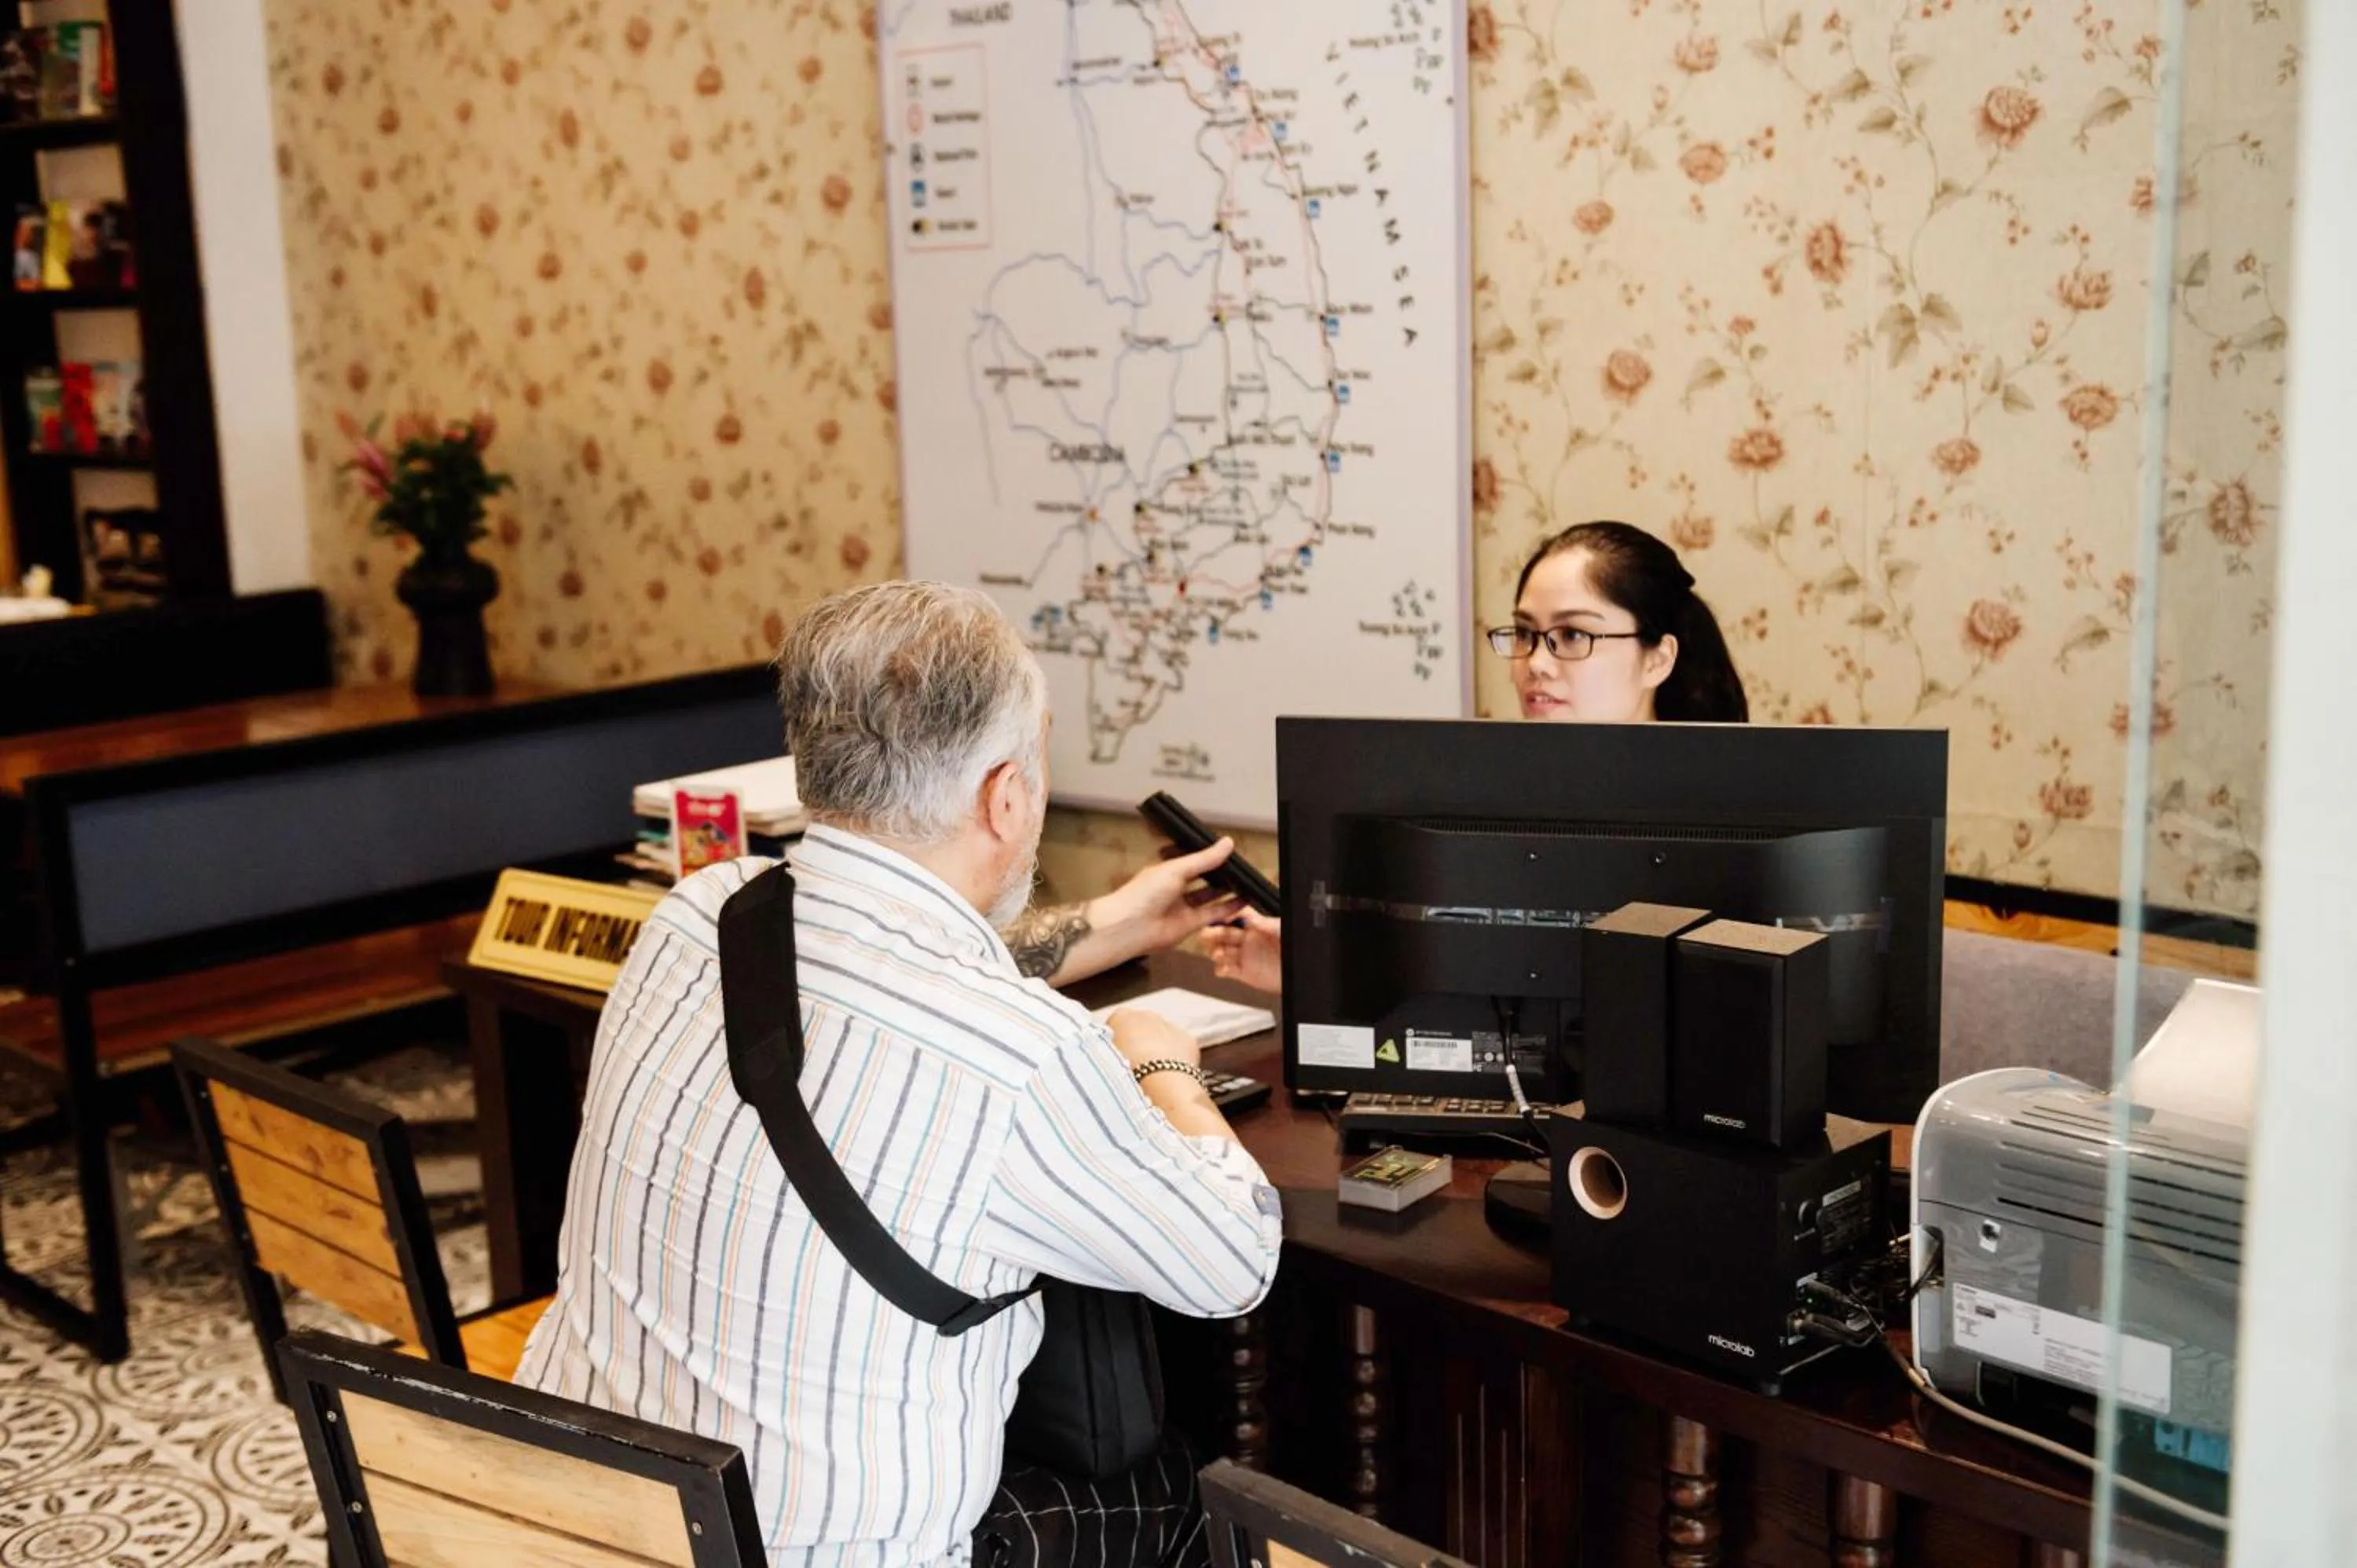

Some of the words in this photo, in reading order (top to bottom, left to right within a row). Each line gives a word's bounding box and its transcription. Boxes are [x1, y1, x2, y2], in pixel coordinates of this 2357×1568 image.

[495, 896, 550, 947] TOUR
[1703, 1113, 1747, 1129] microlab
[1708, 1335, 1755, 1357] microlab
